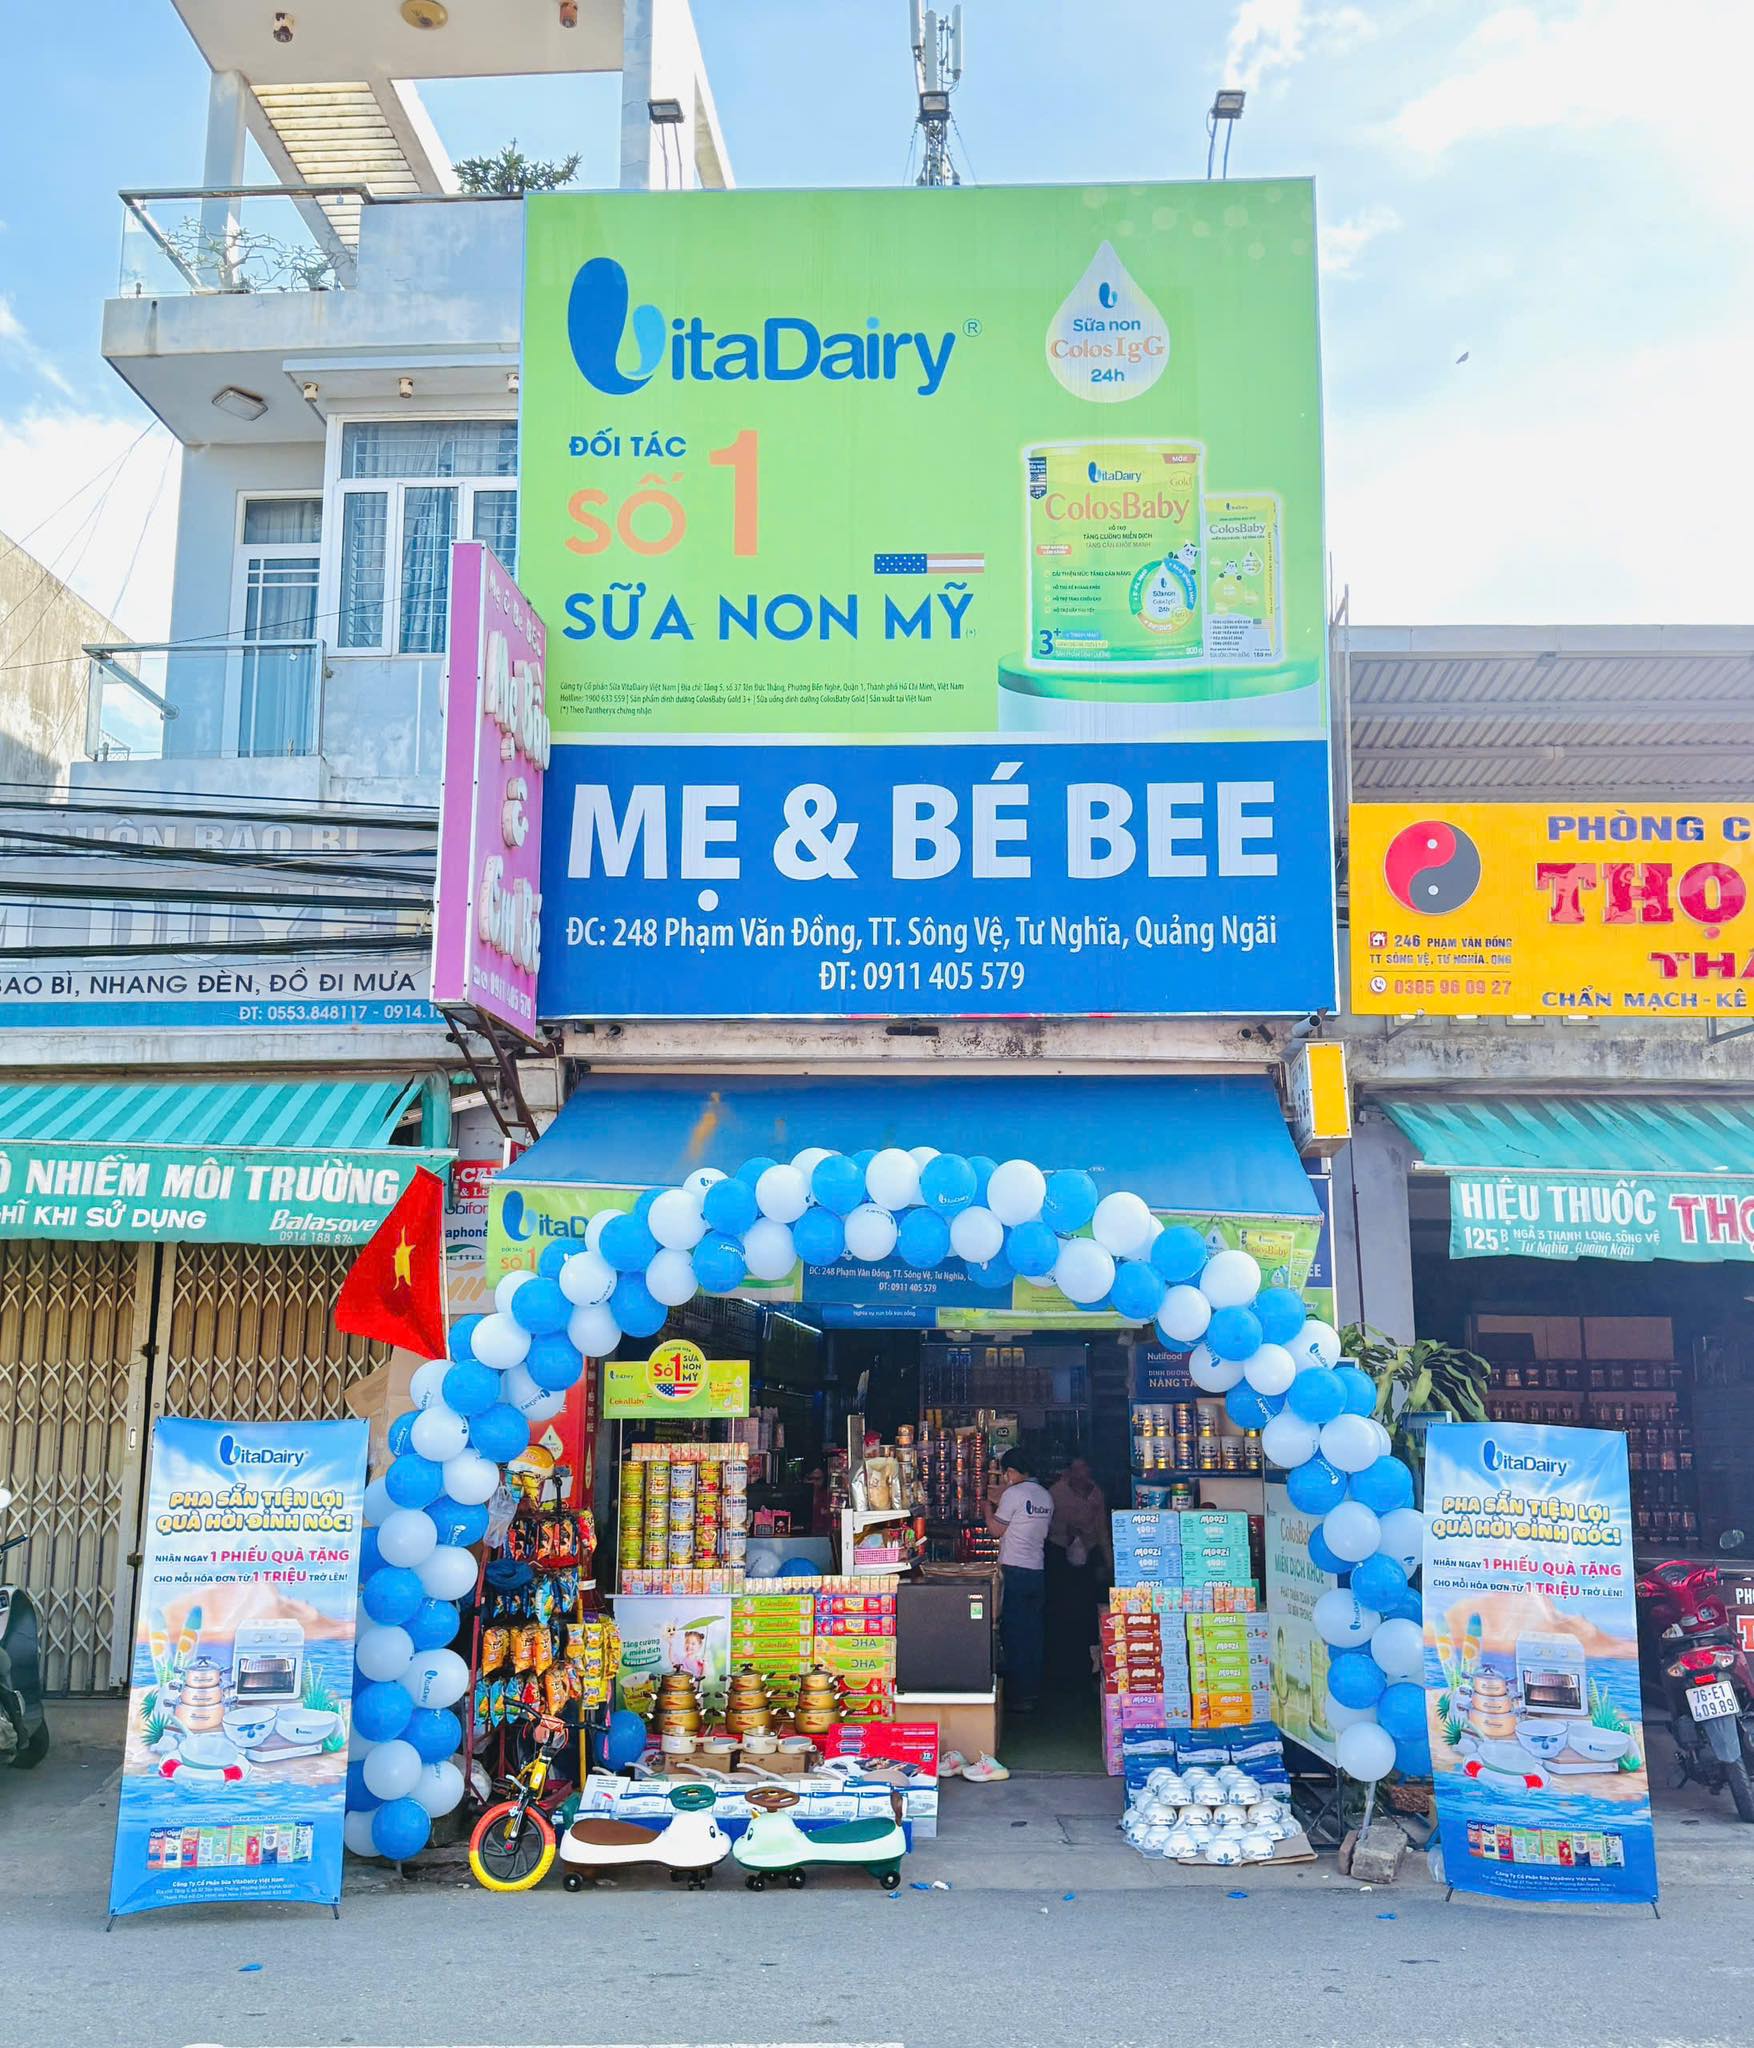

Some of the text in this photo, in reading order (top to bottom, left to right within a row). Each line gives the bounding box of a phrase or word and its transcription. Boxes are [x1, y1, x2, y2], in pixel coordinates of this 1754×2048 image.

[567, 257, 956, 395] VitaDairy
[1073, 317, 1141, 331] Sữa non
[1091, 368, 1124, 382] 24h
[569, 428, 687, 457] ĐỐI TÁC
[564, 429, 759, 557] SỐ 1
[1045, 492, 1190, 523] ColosBaby
[1209, 523, 1266, 535] ColosBaby
[562, 582, 694, 641] SỮA
[719, 593, 858, 641] NON
[885, 582, 974, 641] MỸ
[567, 761, 1278, 912] MẸ & BÉ BEE
[1548, 809, 1705, 842] PHÒNG
[1536, 862, 1747, 939] THỌ
[566, 914, 1277, 953] ĐC: 248 Phạm Văn Đồng, TT. Sông Vệ, Tư Nghĩa, Quảng Ngãi
[1394, 935, 1420, 947] 246
[1427, 939, 1457, 949] PHẠM
[1370, 953, 1413, 964] TT SÔNG
[0, 967, 416, 997] AO BÌ, NHANG ĐÈN, ĐỒ ĐI MƯA
[819, 961, 1025, 990] ĐT: 0911 405 579
[1394, 979, 1512, 995] 0385 96 09 27
[1541, 985, 1613, 1007] CHẨN
[239, 1005, 367, 1021] ĐT: 0553.848117
[25, 1153, 150, 1196] NHIỄM
[162, 1156, 235, 1200] MÔI
[244, 1158, 400, 1205] TRƯỜNG
[1460, 1175, 1656, 1225] HIỆU THUỐC
[0, 1200, 207, 1234] HĨ KHI SỬ DỤNG
[269, 1209, 378, 1232] Balasove
[279, 1231, 353, 1244] 0914 188 876
[1520, 1240, 1536, 1253] Tư
[1537, 1240, 1568, 1256] Nghĩa
[1537, 1228, 1661, 1245] 3 THANH VỆ
[822, 1266, 835, 1276] 248
[836, 1267, 856, 1278] Phạm
[857, 1268, 870, 1277] Văn
[903, 1270, 921, 1280] Sông
[935, 1271, 943, 1280] Tư
[891, 1282, 937, 1293] 0911 405 579
[683, 1363, 701, 1371] NON
[1147, 1352, 1182, 1360] Nutifood
[219, 1435, 304, 1467] VitaDairy
[1483, 1440, 1567, 1476] VitaDairy
[169, 1483, 343, 1512] PHA SẴN TIỆN LỢI
[1442, 1489, 1609, 1524] PHA SẴN TIỆN LỢI
[156, 1506, 353, 1535] QUÀ HỜI ĐỈNH NÓC!
[1432, 1514, 1621, 1545] QUÀ HỜI ĐỈNH NÓC!
[155, 1545, 349, 1565] NHẬN NGAY 1 PHIẾU QUÀ TẶNG
[1433, 1554, 1622, 1578] NHẬN NGAY 1 PHIẾU QUÀ TẶNG
[174, 1573, 192, 1583] MỖI
[194, 1574, 214, 1583] HÓA
[215, 1575, 235, 1583] ĐƠN
[238, 1574, 250, 1582] TỪ
[252, 1571, 258, 1582] 1
[263, 1567, 306, 1585] TRIỆU
[309, 1572, 327, 1582] TRỞ
[328, 1573, 348, 1581] LÊN!
[1433, 1578, 1623, 1600] CHO MỖI HÓA ĐƠN TỪ 1 TRIỆU TRỞ LÊN!
[1693, 1685, 1726, 1703] 76-E1
